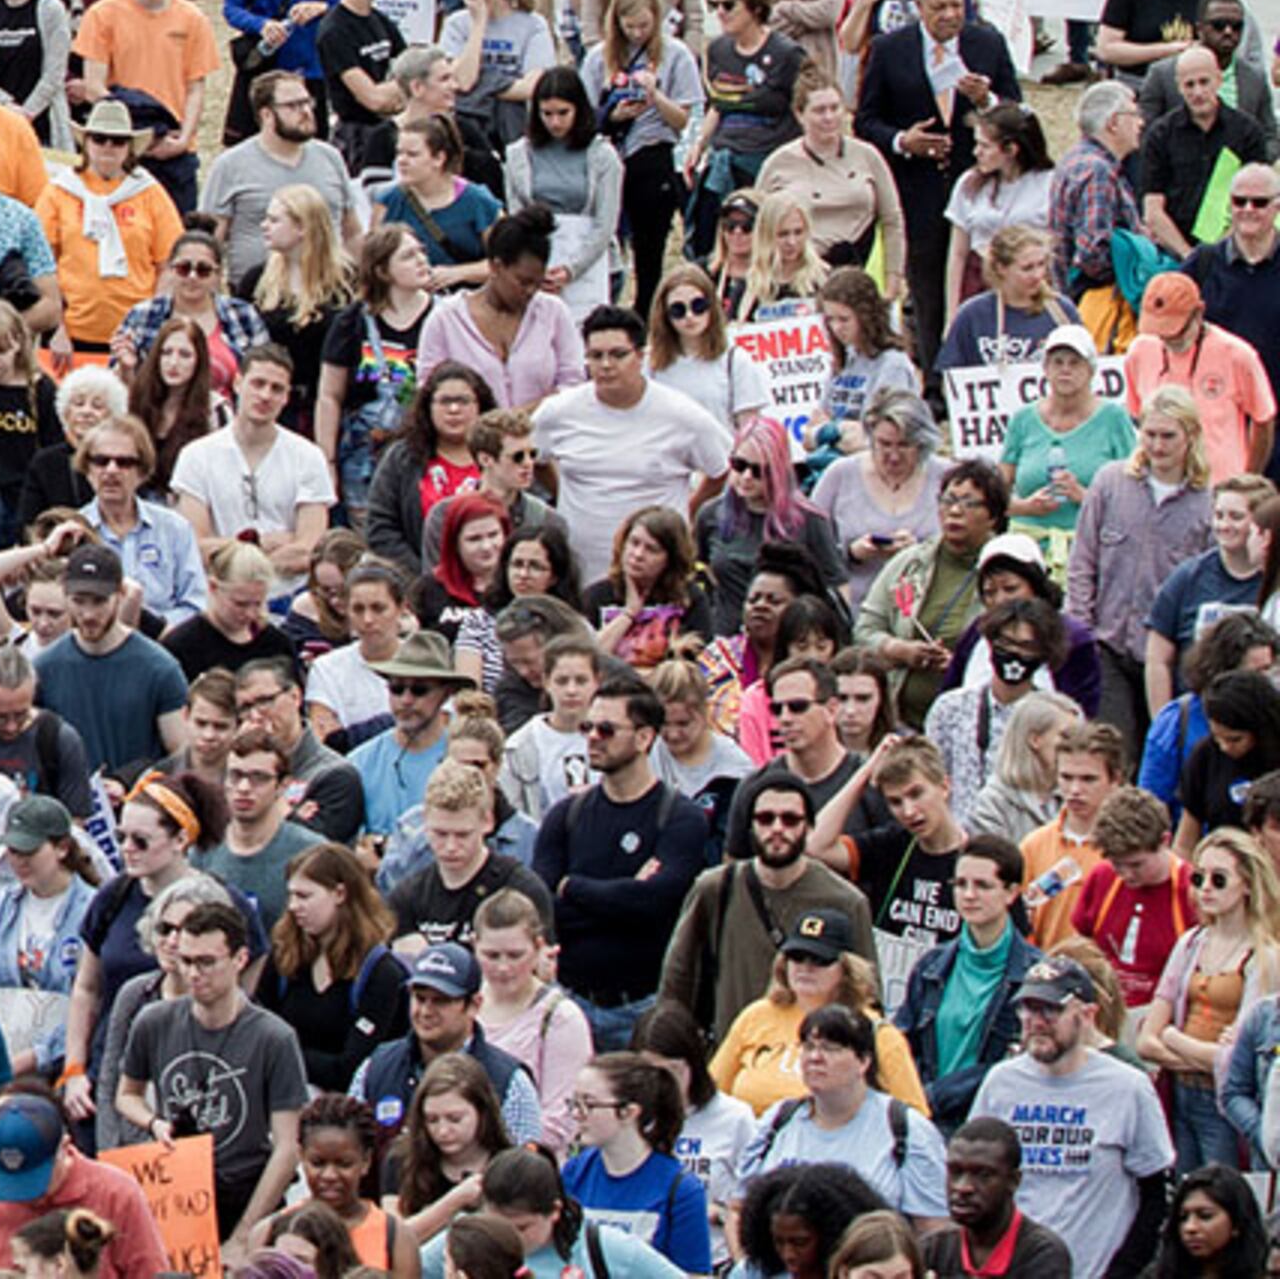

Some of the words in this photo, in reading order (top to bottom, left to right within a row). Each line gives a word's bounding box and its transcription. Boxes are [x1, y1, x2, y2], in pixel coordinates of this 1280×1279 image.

[965, 382, 1001, 413] IT
[913, 880, 941, 905] WE
[889, 899, 923, 924] CAN
[924, 906, 963, 933] END
[1012, 1105, 1086, 1125] MARCH
[1052, 1128, 1095, 1147] OUR
[132, 1162, 172, 1187] WE
